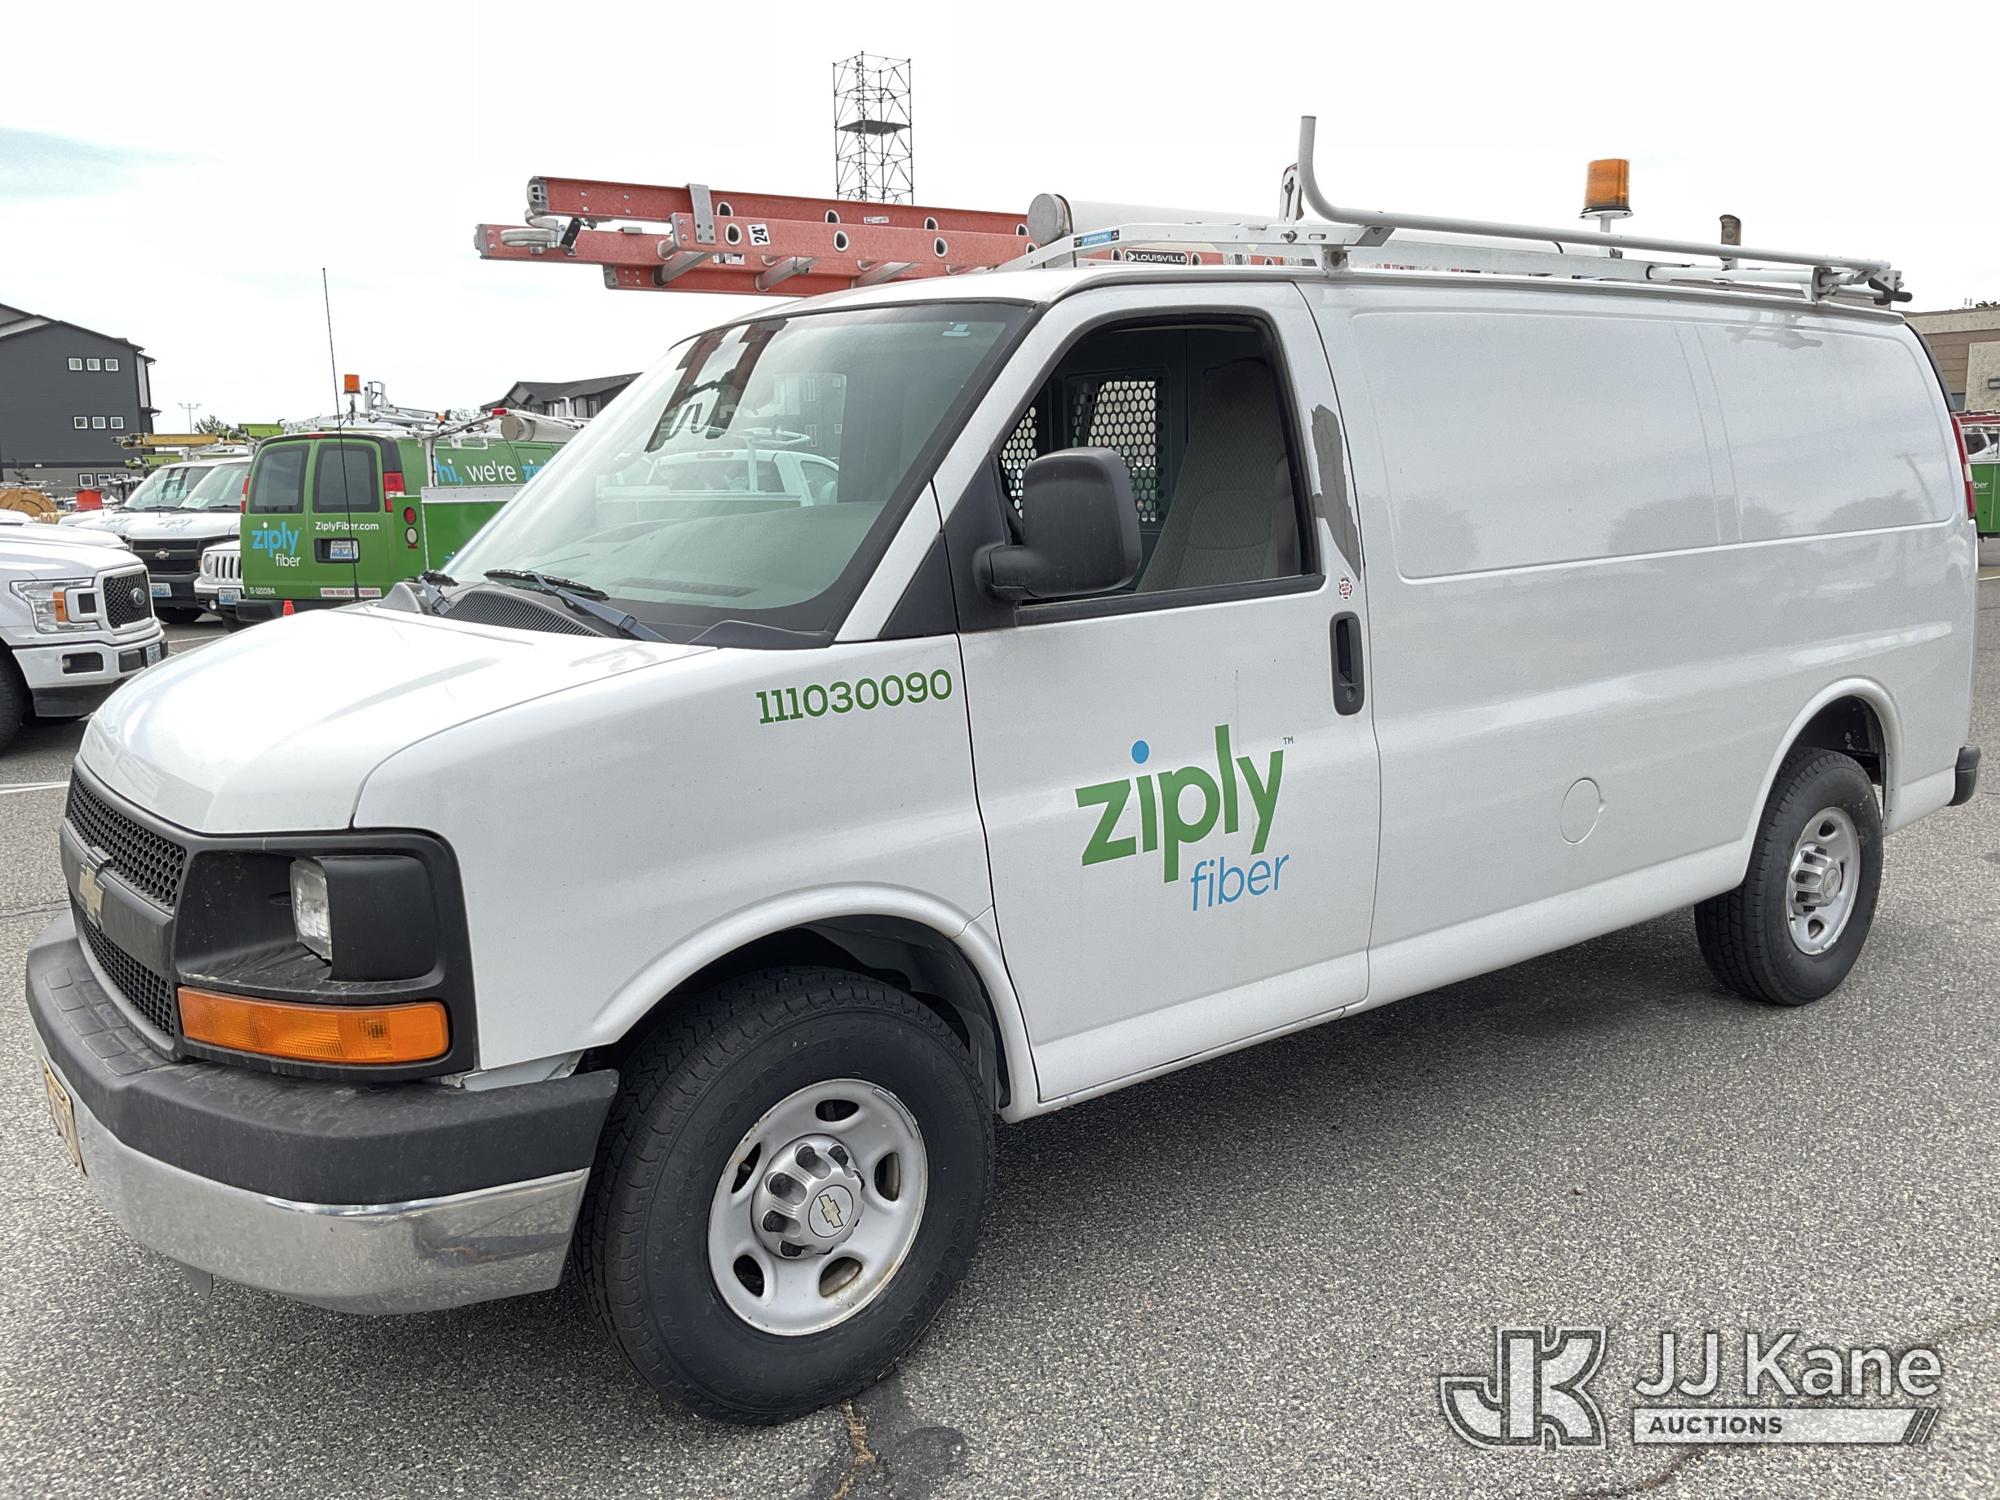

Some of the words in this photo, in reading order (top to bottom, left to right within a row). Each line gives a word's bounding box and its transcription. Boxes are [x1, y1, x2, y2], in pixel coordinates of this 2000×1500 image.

[1135, 252, 1187, 263] LOUISVILLE
[436, 457, 465, 486] hi,
[465, 460, 518, 482] we're
[251, 521, 301, 558] ziply
[315, 521, 380, 532] ZiplyFiber.com
[275, 553, 301, 567] fiber
[756, 668, 953, 725] 111030090
[1076, 724, 1284, 883] ziply
[1190, 854, 1292, 912] fiber
